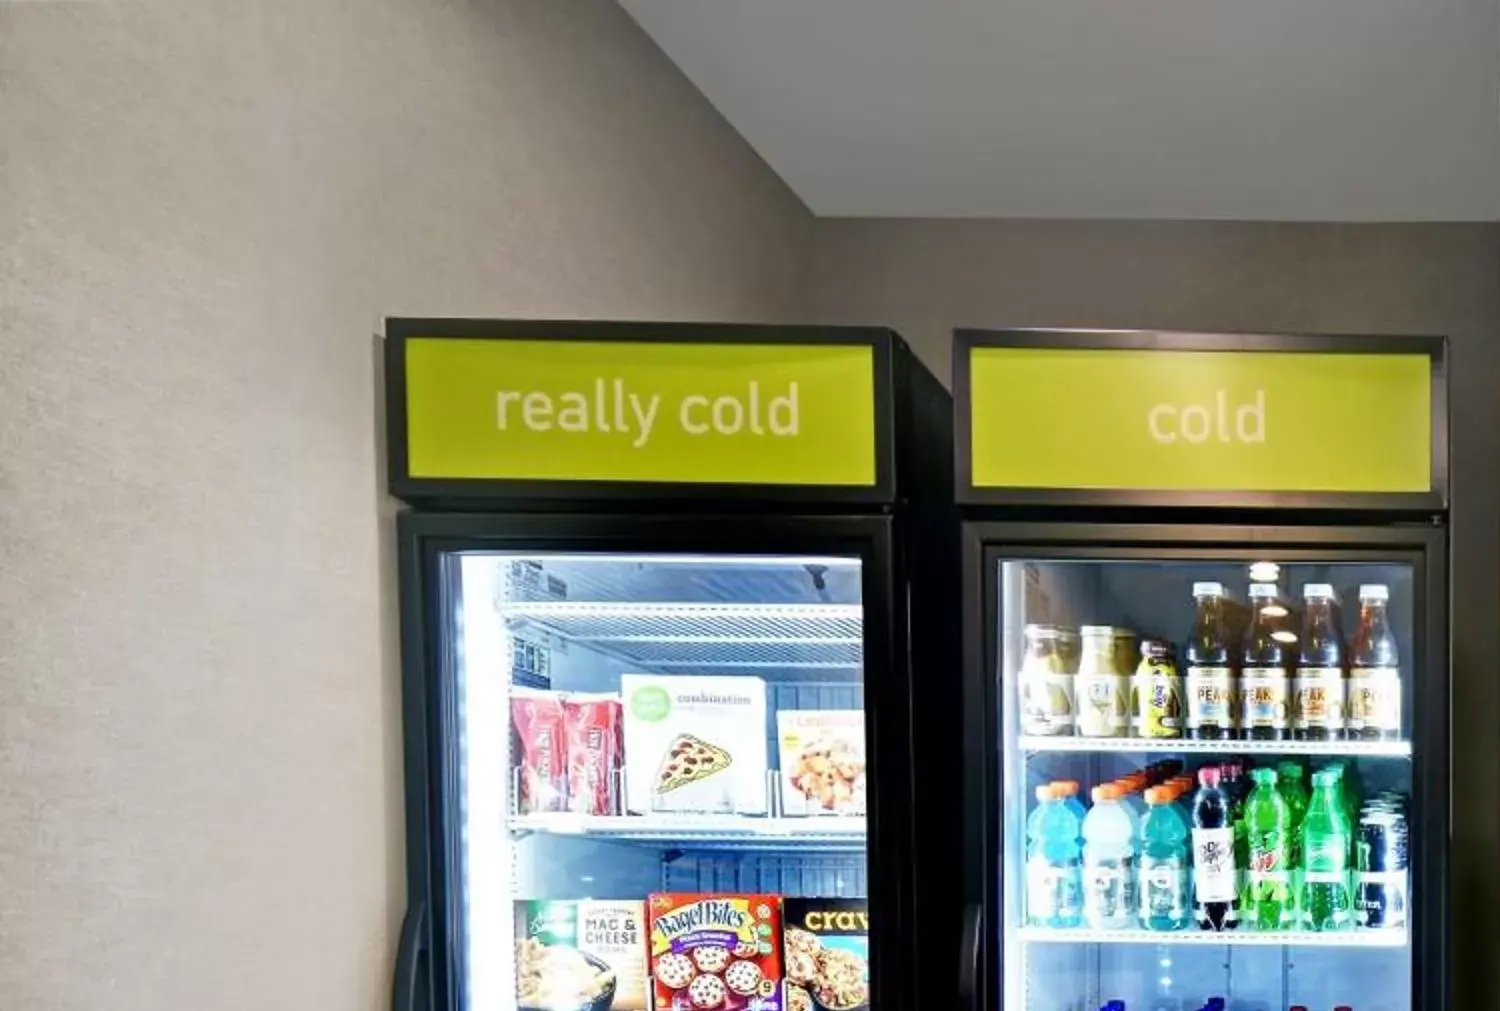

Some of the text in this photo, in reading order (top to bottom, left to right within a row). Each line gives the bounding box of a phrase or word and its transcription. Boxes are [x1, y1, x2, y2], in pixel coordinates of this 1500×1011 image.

[496, 377, 799, 448] really cold
[1148, 387, 1266, 444] cold
[585, 918, 637, 931] MAC &
[653, 901, 744, 937] Bagel Bites
[585, 931, 637, 945] CHEESE
